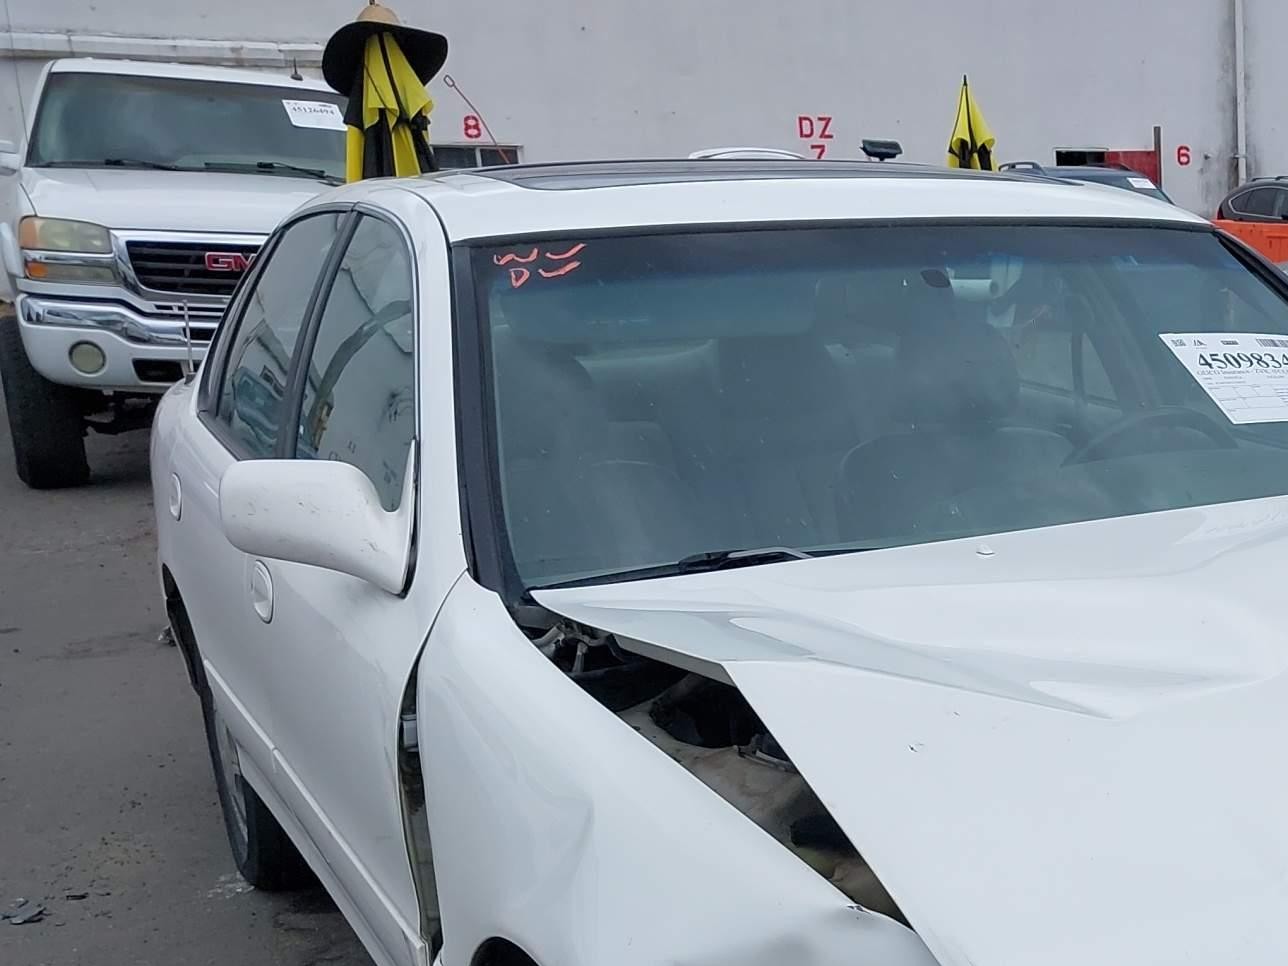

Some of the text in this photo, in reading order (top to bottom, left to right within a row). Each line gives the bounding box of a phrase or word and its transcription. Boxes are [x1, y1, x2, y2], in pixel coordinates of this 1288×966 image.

[463, 115, 482, 139] 8
[798, 116, 834, 139] DZ
[810, 144, 826, 160] 7
[1177, 145, 1191, 166] 6
